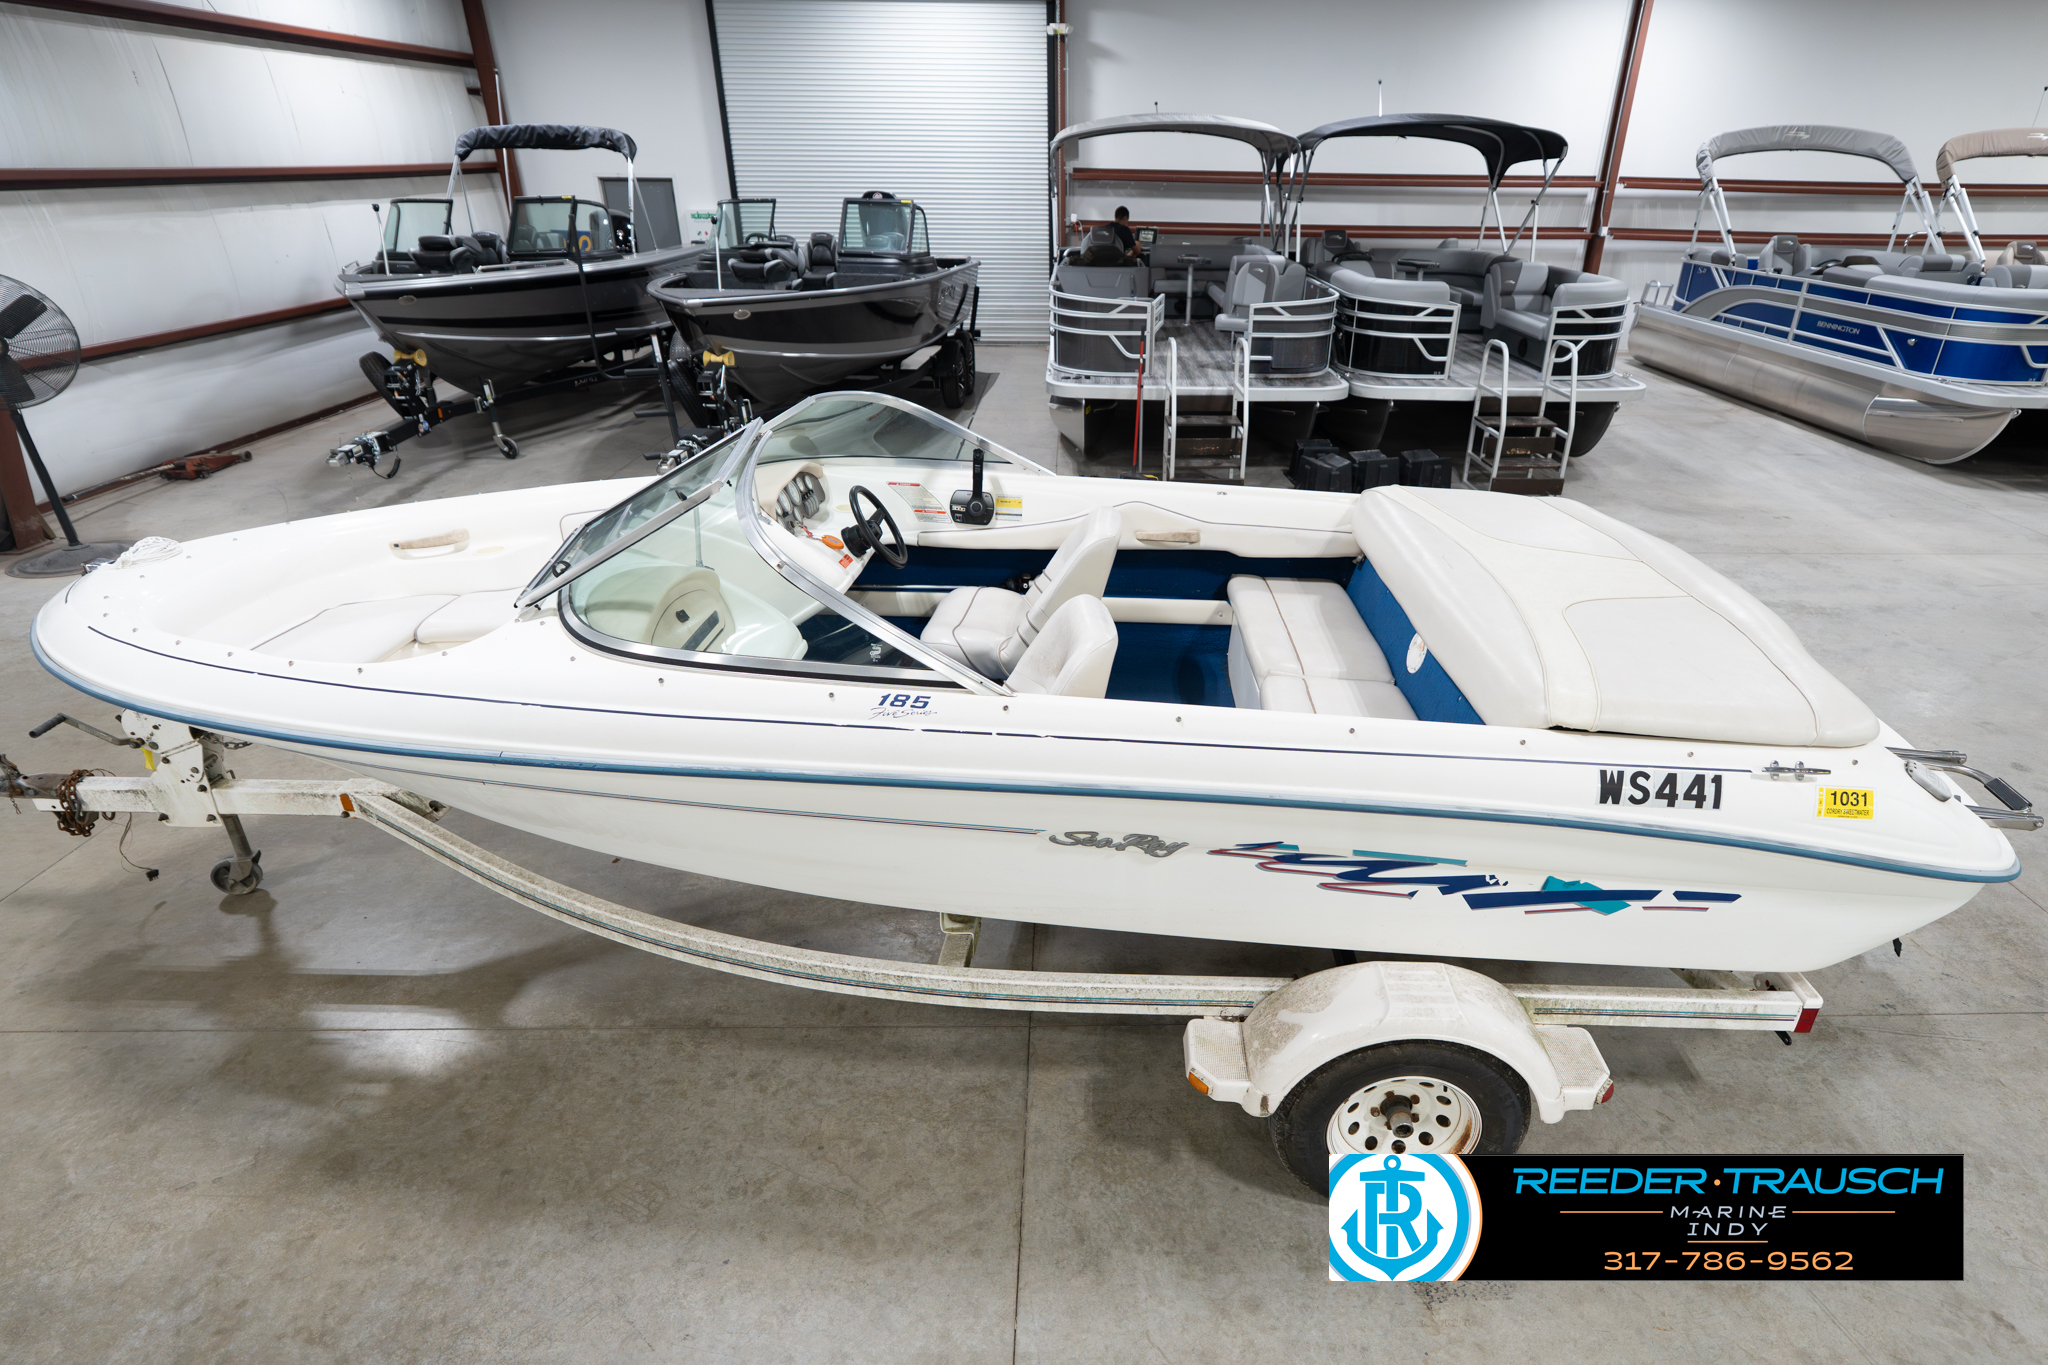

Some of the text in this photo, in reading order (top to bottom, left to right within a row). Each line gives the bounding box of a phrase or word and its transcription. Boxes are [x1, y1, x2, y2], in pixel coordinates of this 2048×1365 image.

[1817, 320, 1860, 335] BENNINGTON
[878, 693, 931, 709] 185
[1599, 770, 1722, 809] WS441
[1831, 791, 1867, 806] 1031
[1049, 831, 1189, 858] Sea Ray
